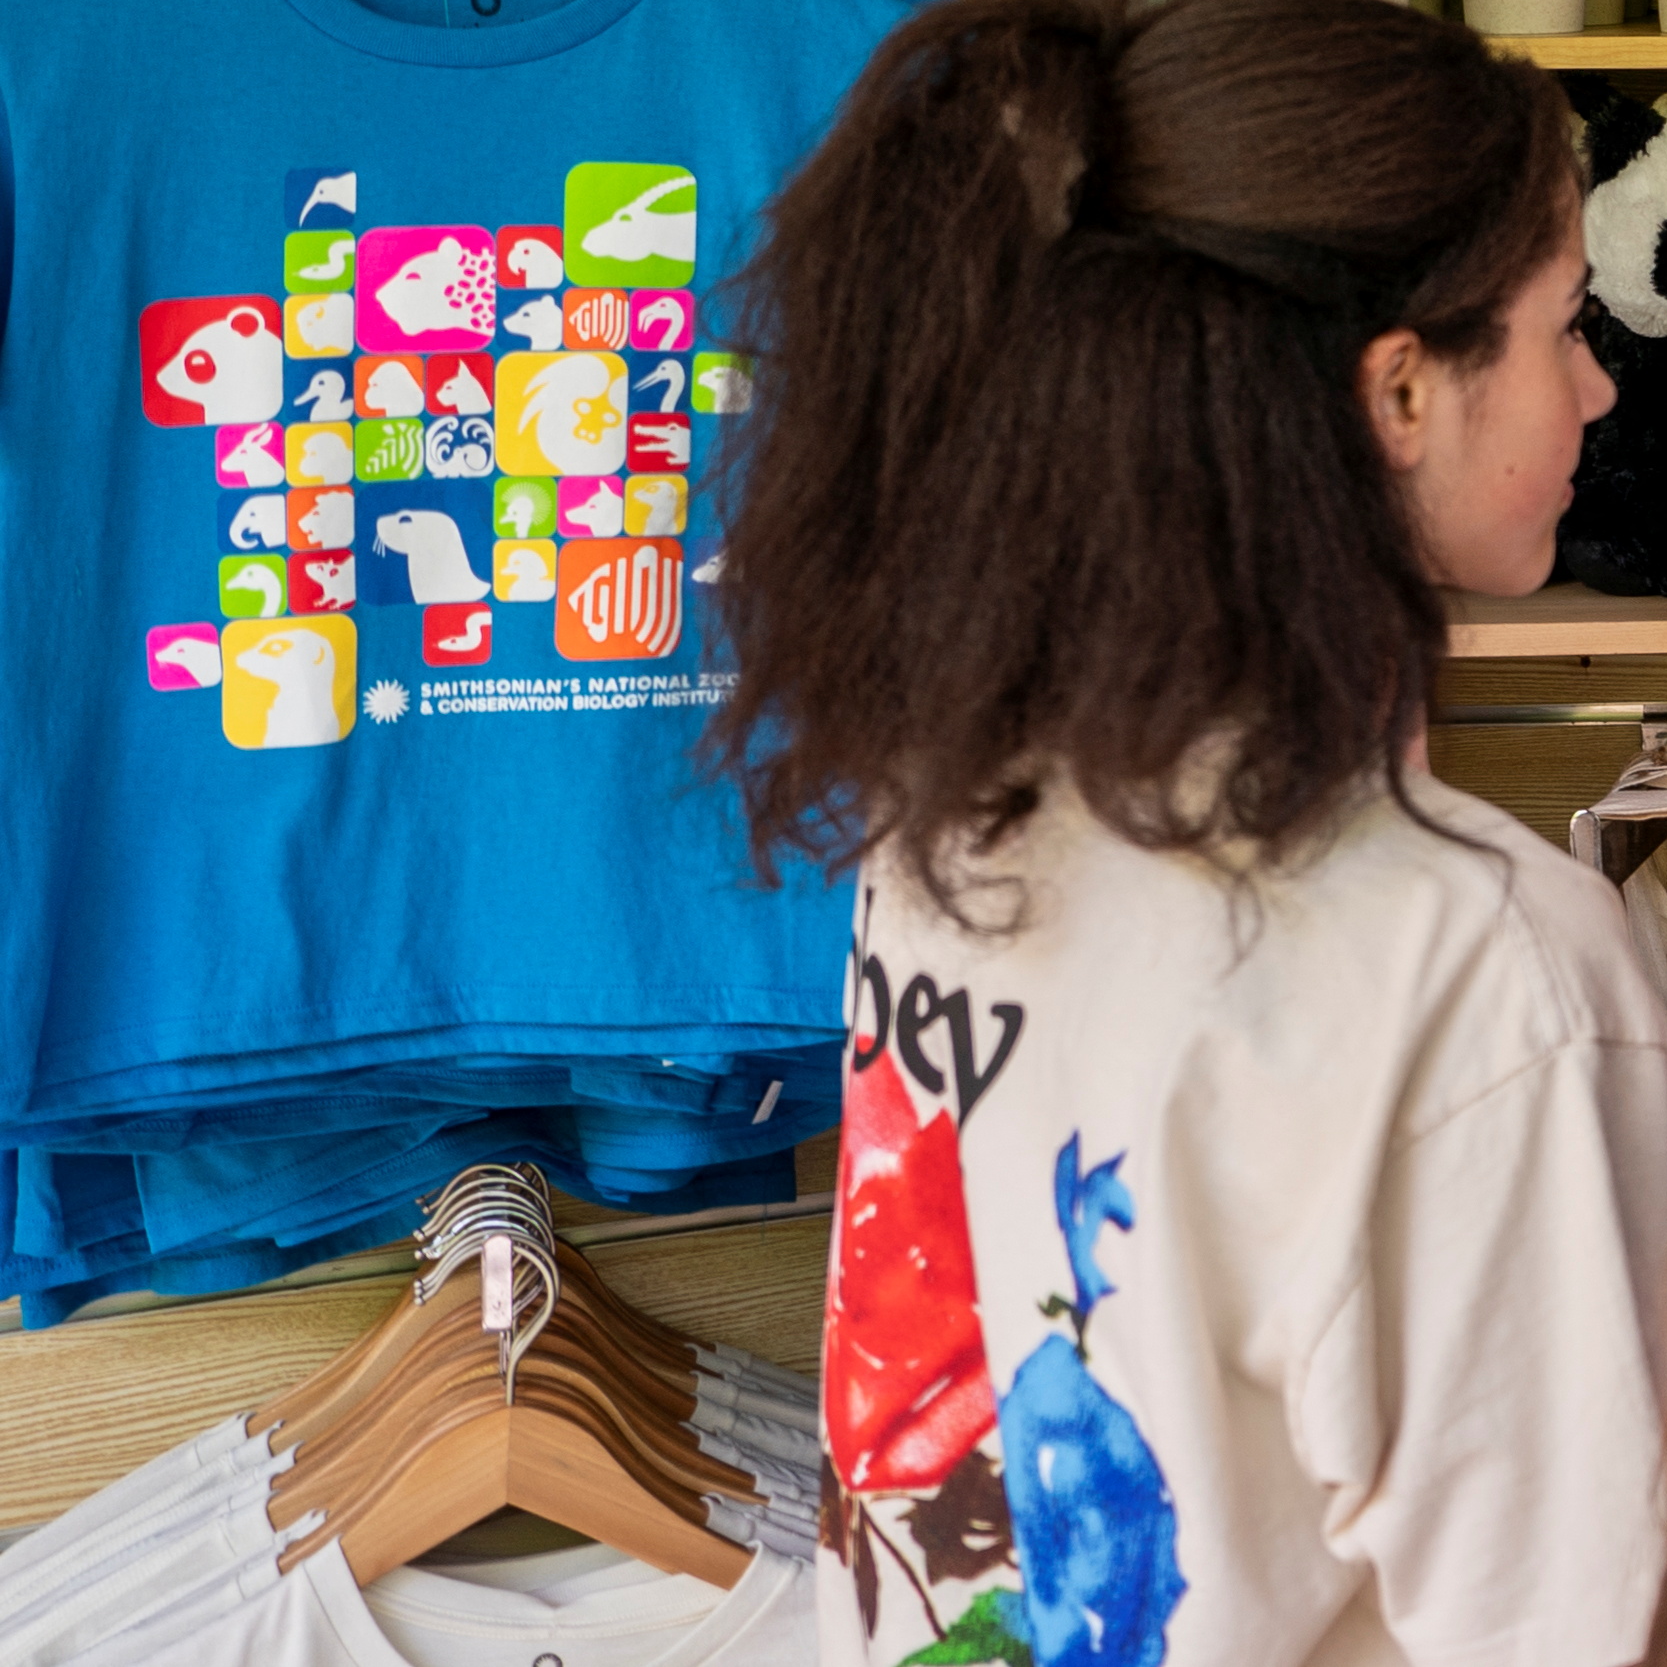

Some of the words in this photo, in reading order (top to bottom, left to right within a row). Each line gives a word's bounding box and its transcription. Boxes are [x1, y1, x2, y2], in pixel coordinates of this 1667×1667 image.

[421, 678, 580, 698] SMITHSONIAN'S
[588, 674, 691, 692] NATIONAL
[421, 700, 433, 715] &
[438, 695, 566, 713] CONSERVATION
[573, 693, 647, 710] BIOLOGY
